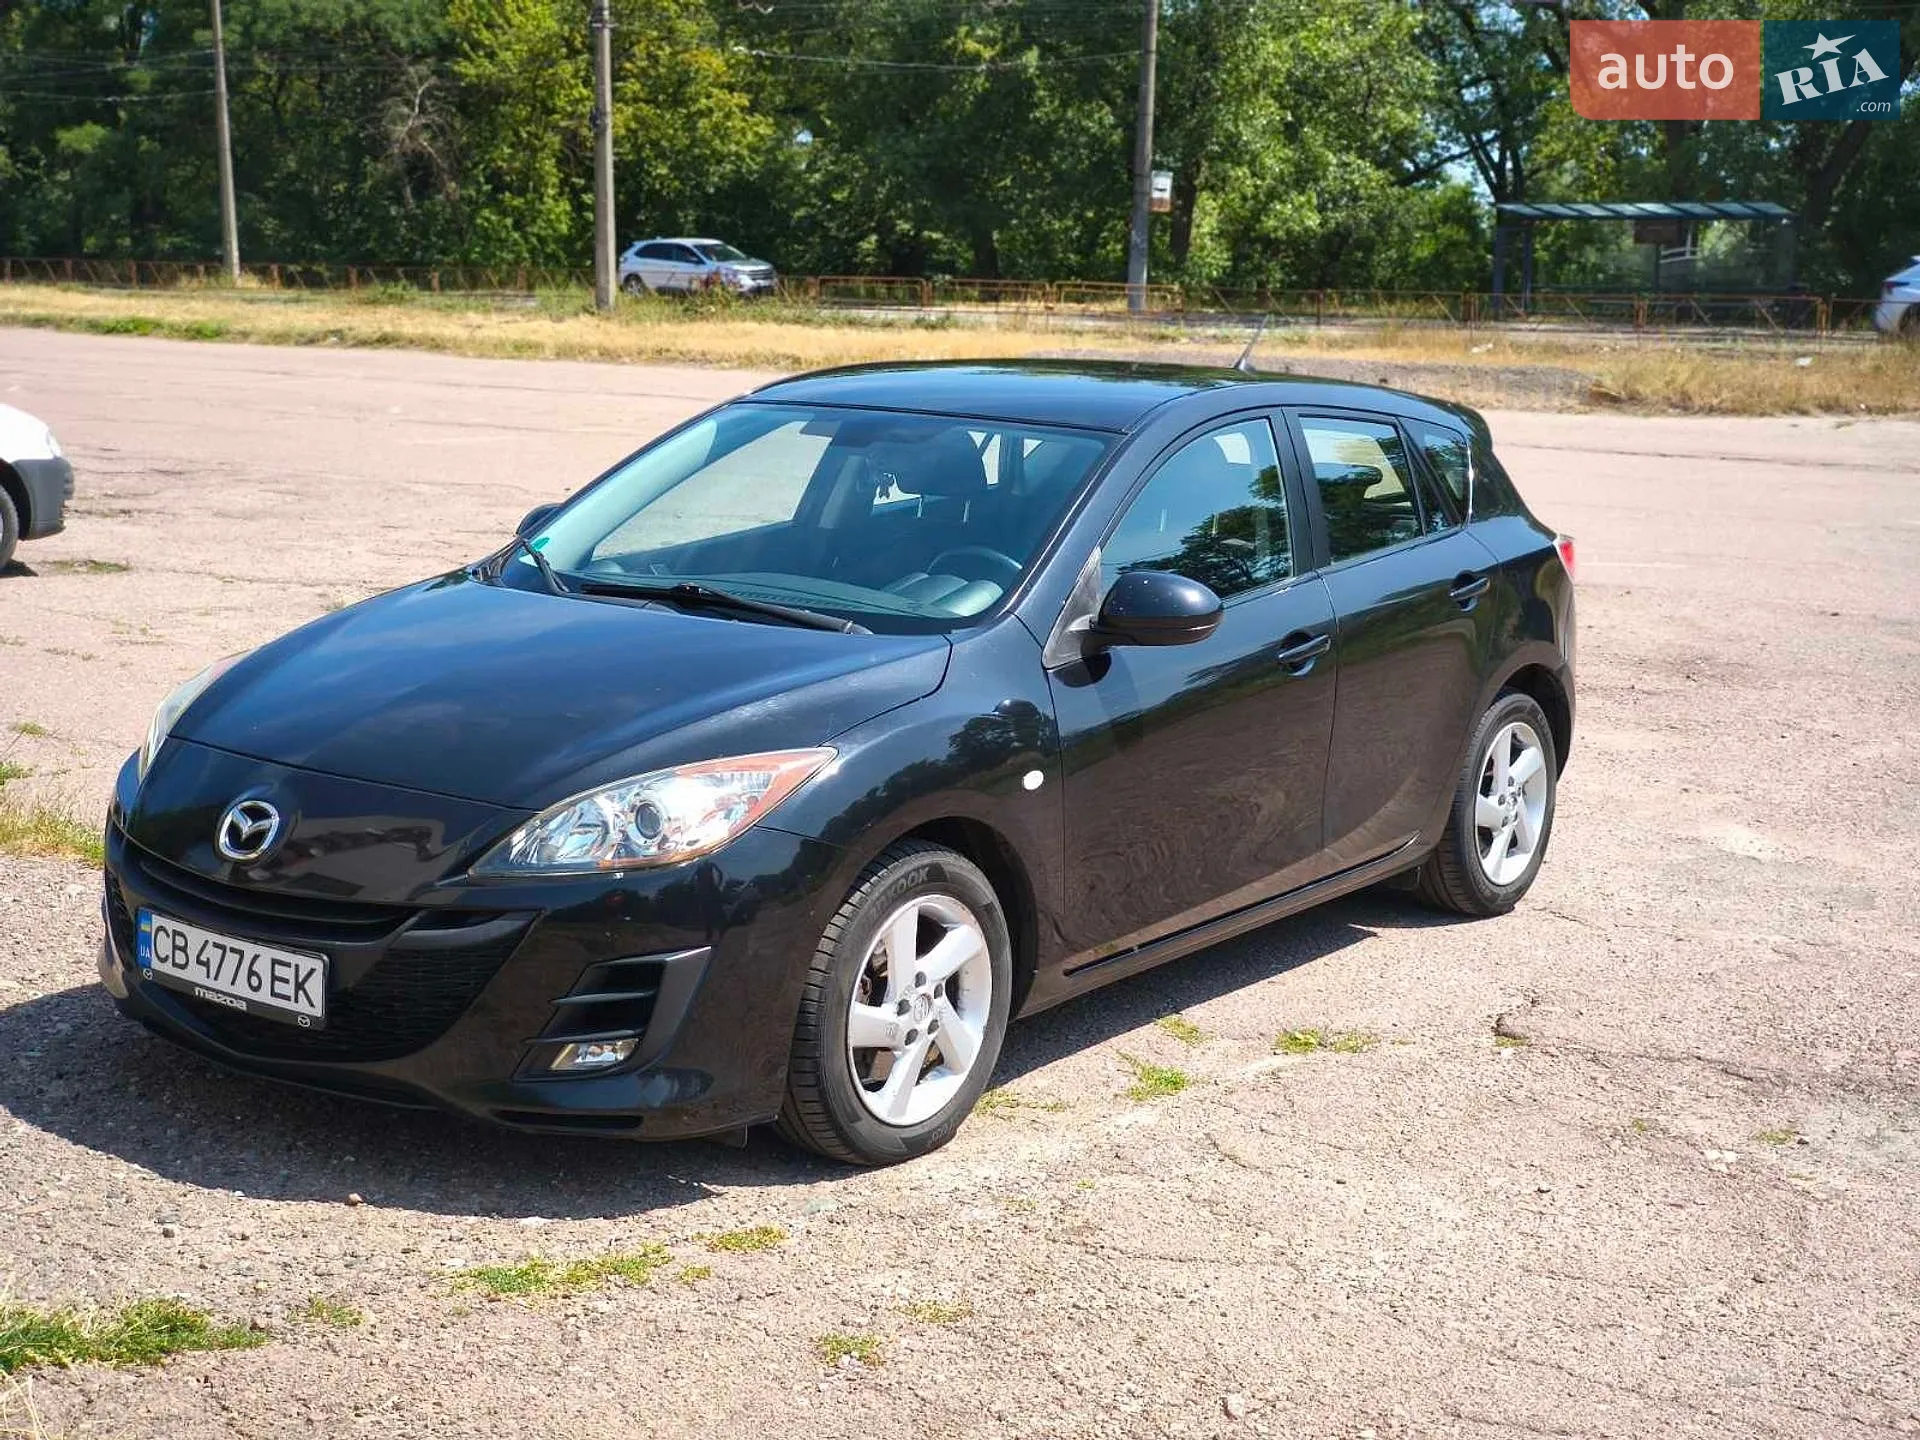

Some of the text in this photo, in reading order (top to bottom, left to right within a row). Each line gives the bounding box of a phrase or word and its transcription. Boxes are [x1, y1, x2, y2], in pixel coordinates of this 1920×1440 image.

[140, 943, 151, 959] UA
[153, 925, 316, 1008] CB 4776 EK
